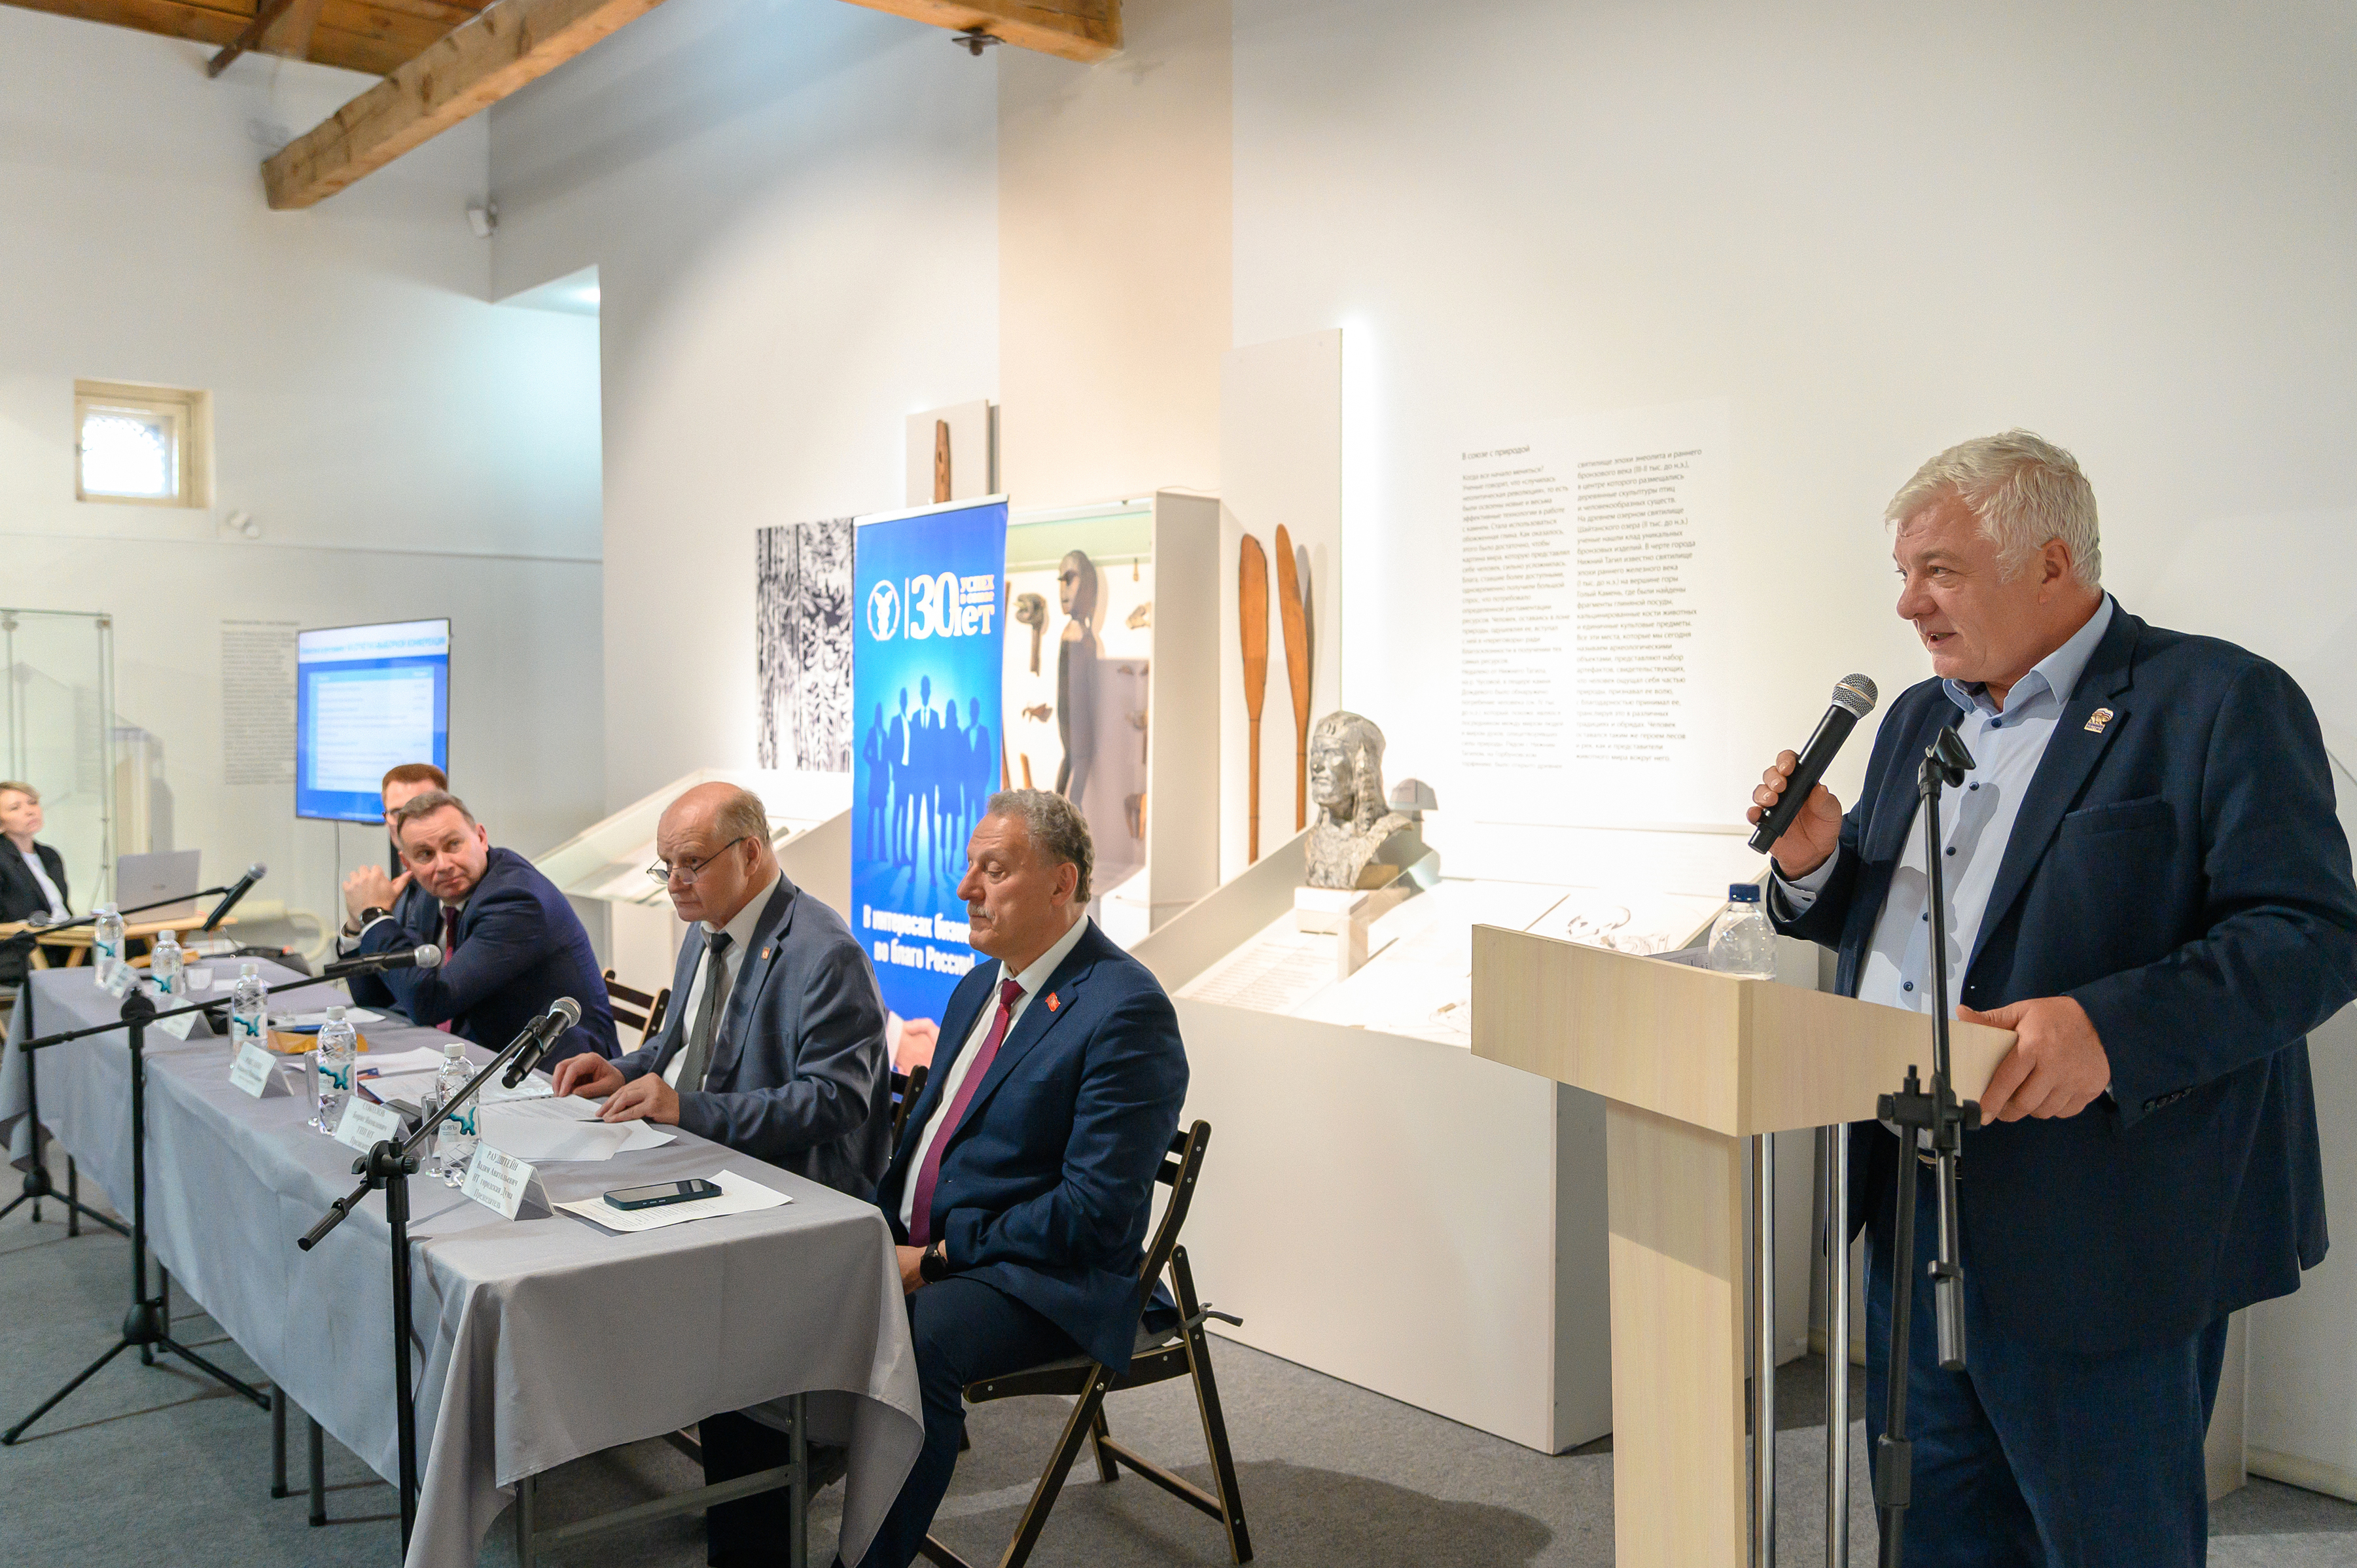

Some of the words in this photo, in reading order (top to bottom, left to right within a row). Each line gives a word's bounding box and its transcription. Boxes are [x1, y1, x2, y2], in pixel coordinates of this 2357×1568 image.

[910, 572, 959, 639] 30
[476, 1160, 490, 1173] Вадим
[491, 1168, 518, 1186] Анатольевич
[486, 1150, 519, 1171] РАУДШТЕЙН
[472, 1173, 480, 1183] НТ
[480, 1179, 502, 1194] городская
[501, 1187, 513, 1200] Дума
